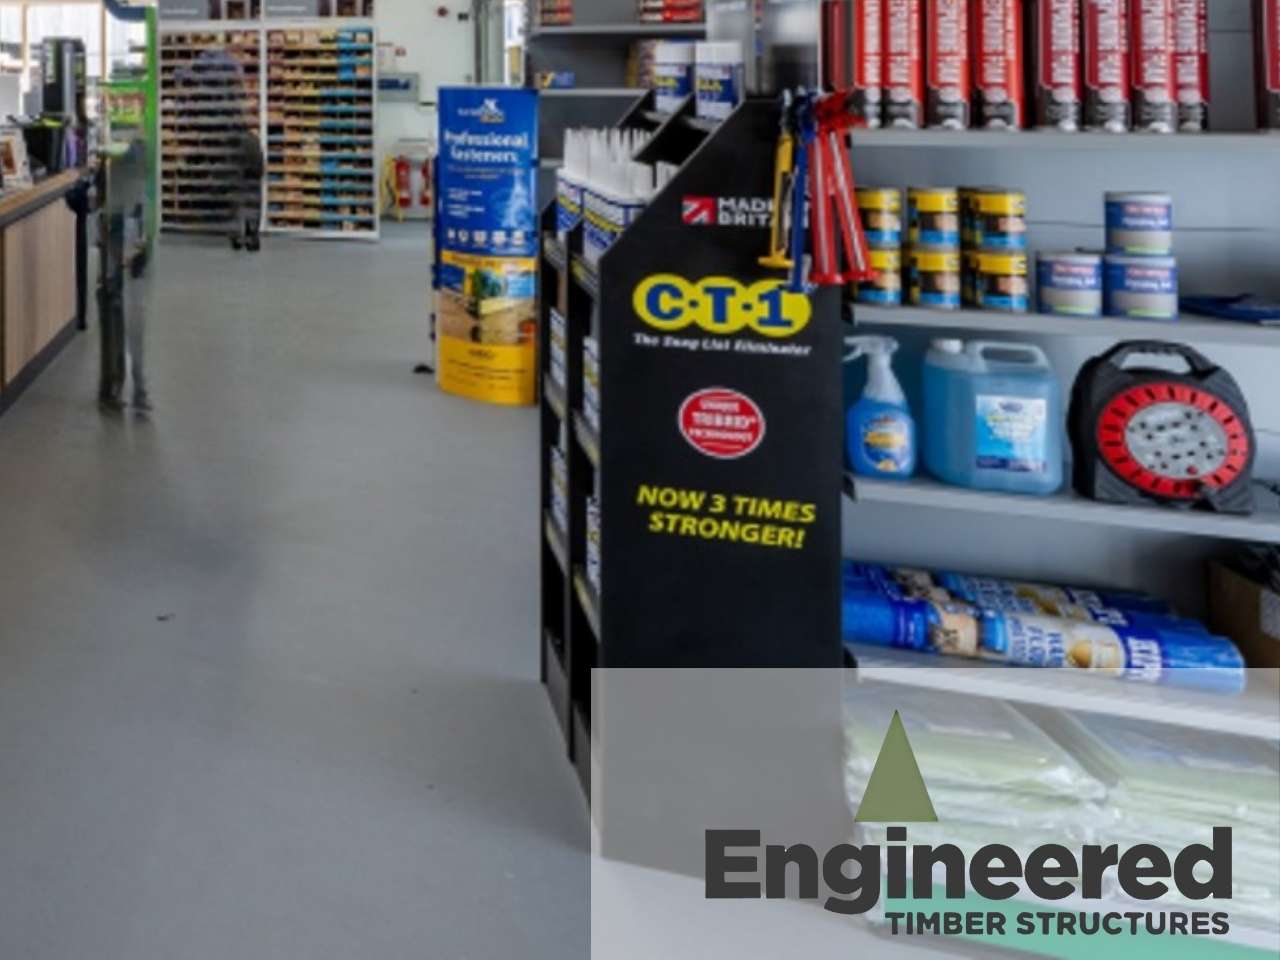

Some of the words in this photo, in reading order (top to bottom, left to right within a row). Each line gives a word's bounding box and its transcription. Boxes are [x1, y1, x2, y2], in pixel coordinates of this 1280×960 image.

[637, 485, 705, 512] NOW
[709, 494, 727, 513] 3
[733, 496, 816, 523] TIMES
[648, 513, 806, 549] STRONGER!
